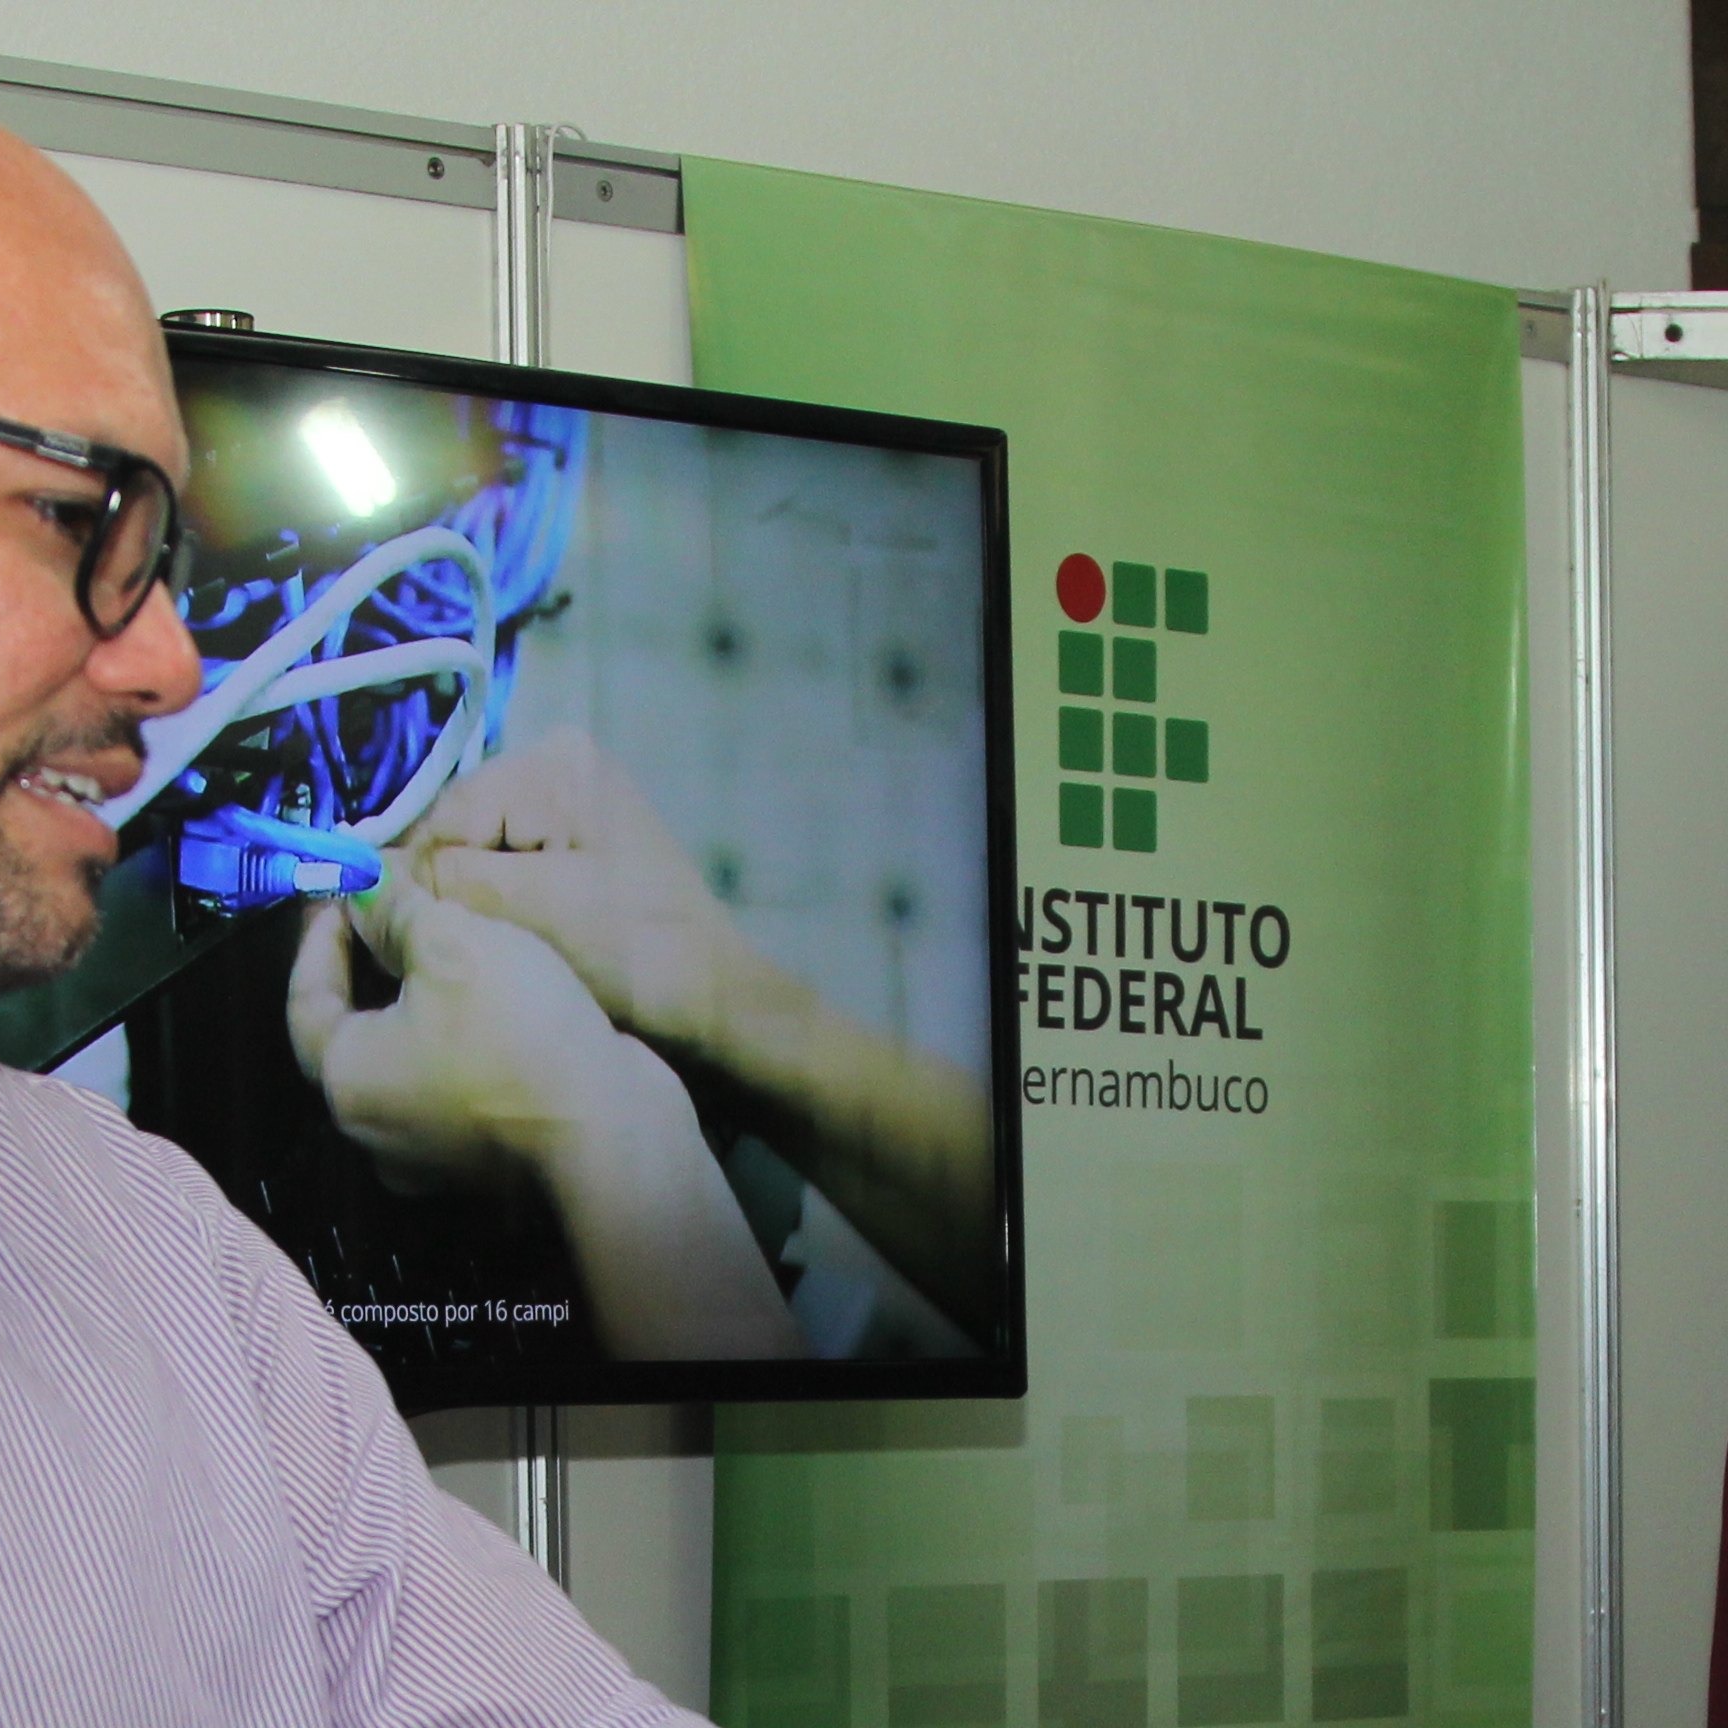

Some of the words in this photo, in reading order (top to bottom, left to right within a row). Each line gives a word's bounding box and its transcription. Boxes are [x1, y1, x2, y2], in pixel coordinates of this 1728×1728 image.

[1017, 886, 1291, 969] STITUTO
[1022, 1059, 1268, 1114] ernambuco
[341, 1301, 439, 1328] composto
[445, 1302, 477, 1328] por
[484, 1300, 508, 1321] 16
[513, 1300, 569, 1327] campi
